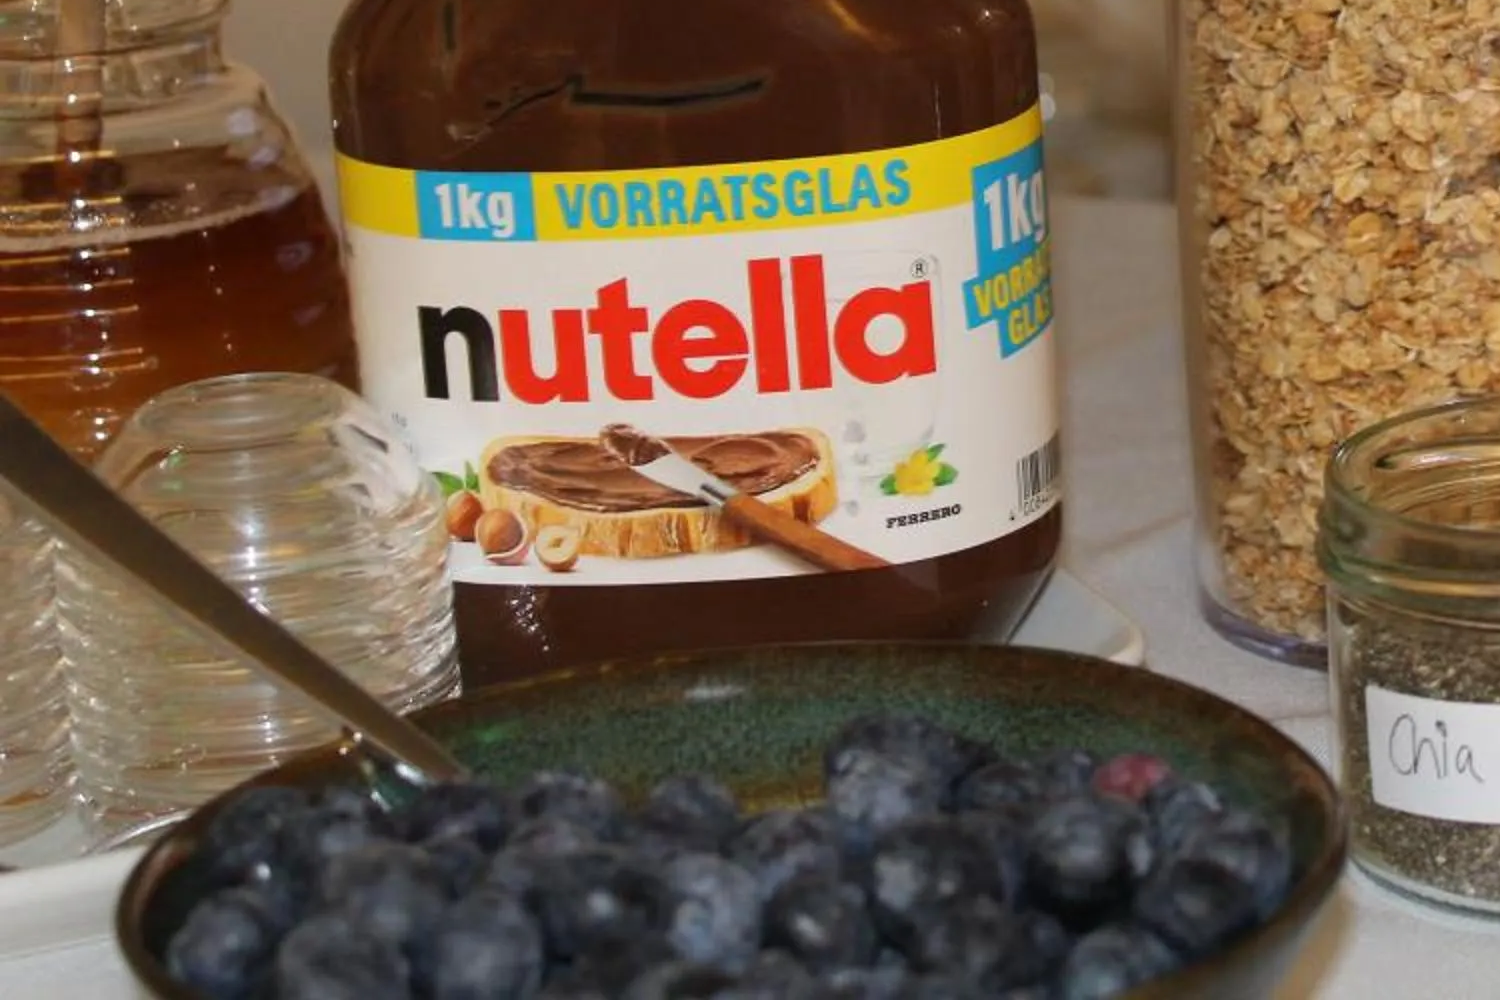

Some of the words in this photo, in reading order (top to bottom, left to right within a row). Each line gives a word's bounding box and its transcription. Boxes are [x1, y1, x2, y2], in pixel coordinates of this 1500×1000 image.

[433, 182, 516, 239] 1kg
[554, 159, 912, 230] VORRATSGLAS
[983, 169, 1046, 252] 1kg
[417, 253, 938, 406] nutella
[885, 503, 962, 529] FERRERO
[1388, 713, 1486, 784] Chia
